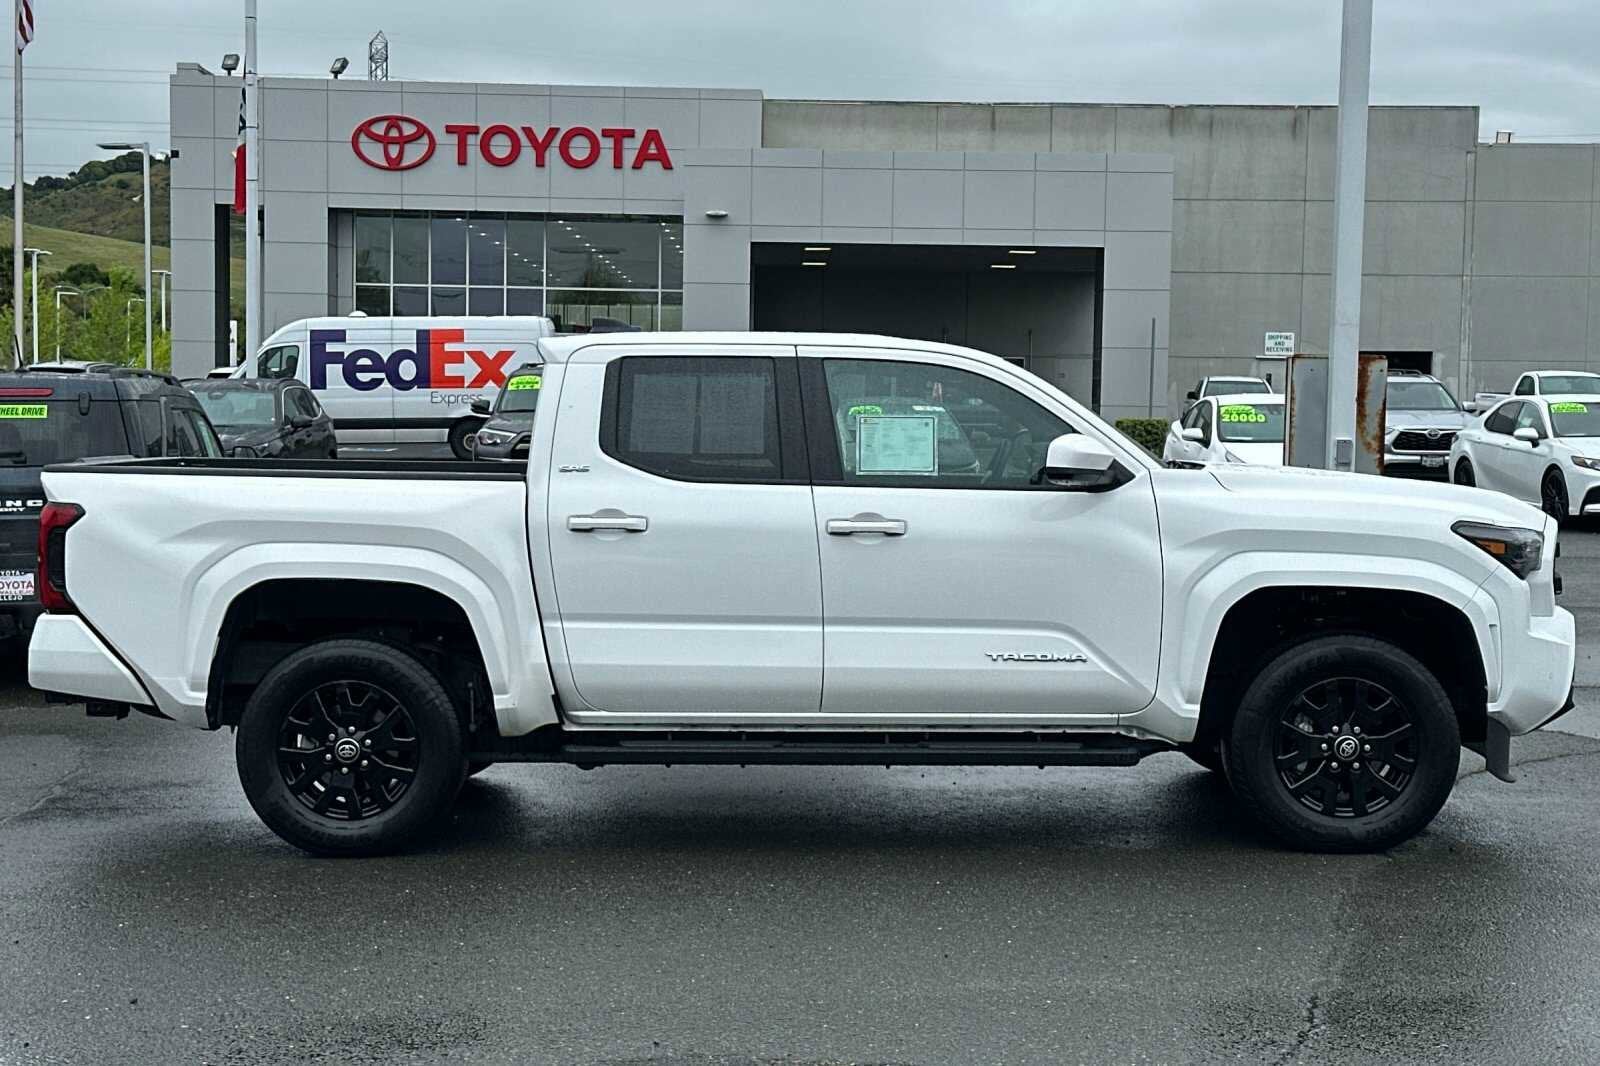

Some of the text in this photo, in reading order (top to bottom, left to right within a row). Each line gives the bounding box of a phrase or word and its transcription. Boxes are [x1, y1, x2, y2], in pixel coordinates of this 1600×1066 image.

[445, 124, 673, 170] TOYOTA
[310, 329, 517, 391] FedEx
[0, 407, 45, 416] HEEL DRIVE
[1221, 413, 1266, 422] 20000
[0, 581, 34, 590] OYOTA
[984, 652, 1088, 662] TACOMA
